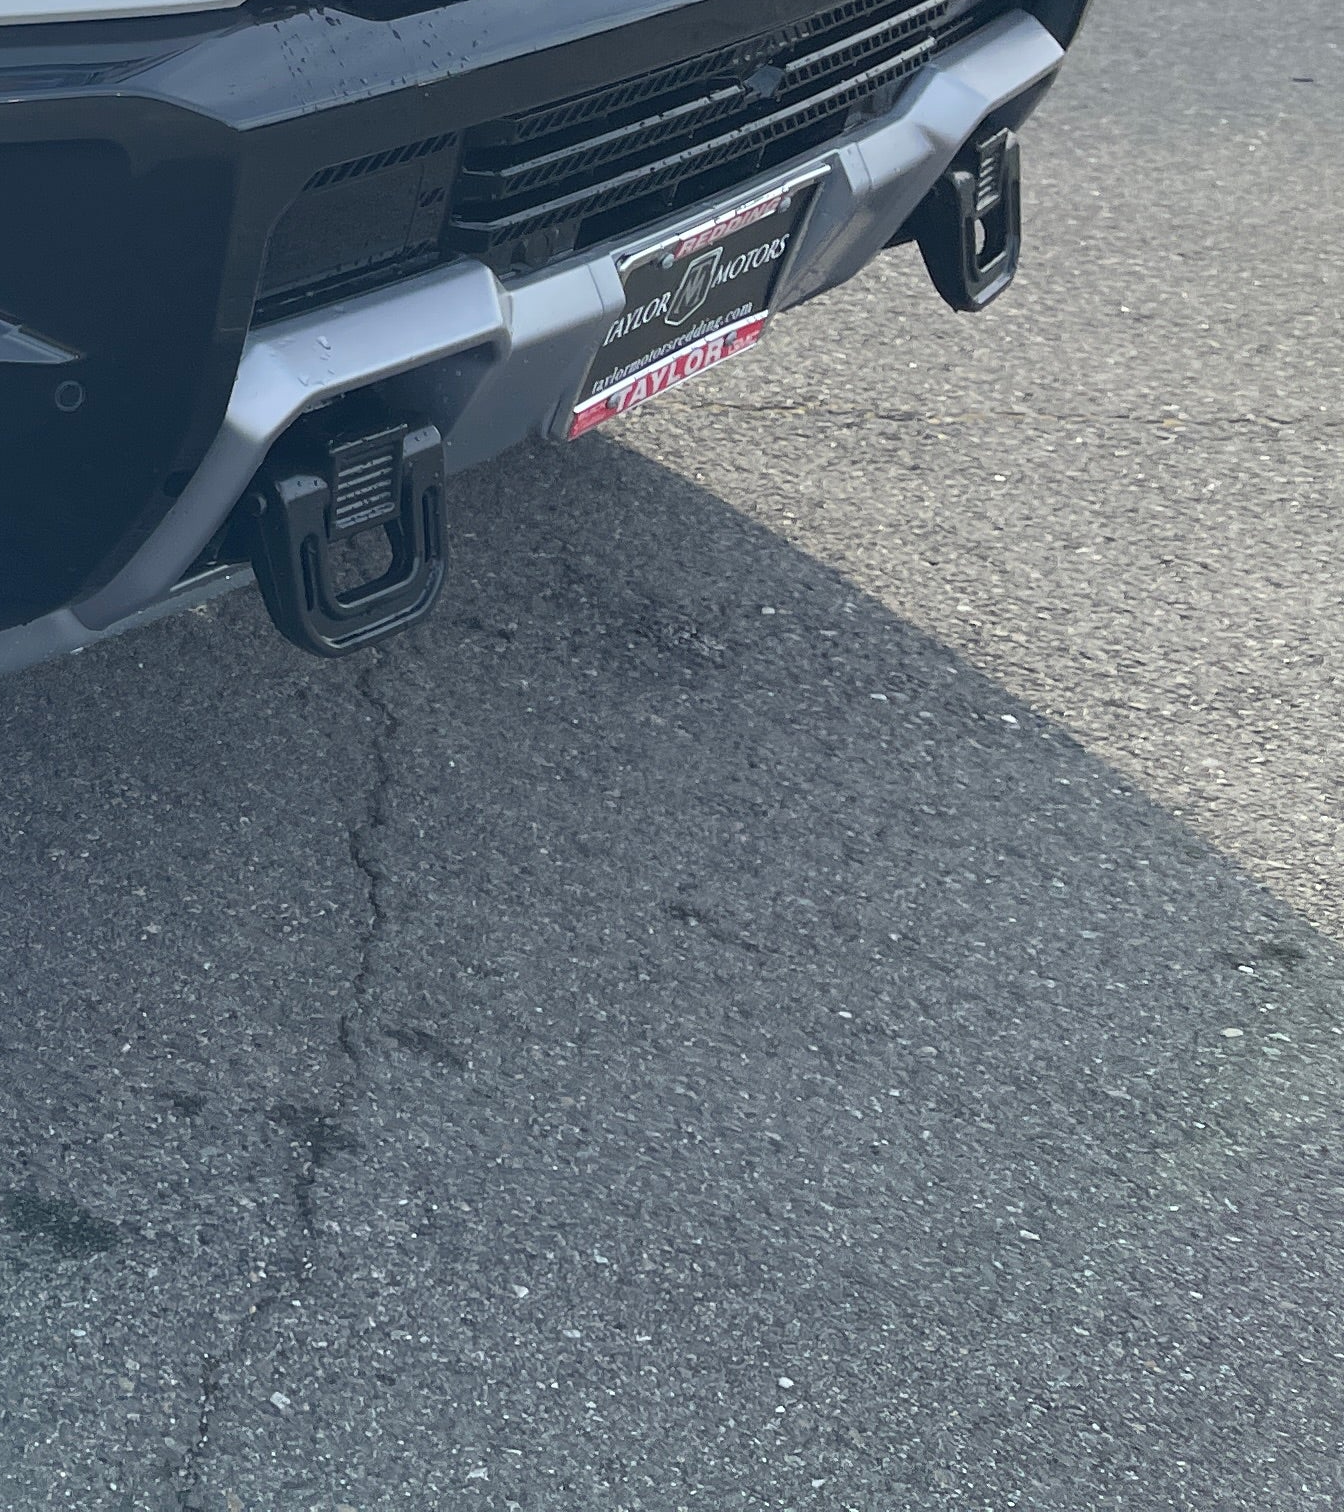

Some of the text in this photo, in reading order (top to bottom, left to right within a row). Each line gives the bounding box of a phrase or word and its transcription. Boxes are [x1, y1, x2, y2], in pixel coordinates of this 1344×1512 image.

[675, 195, 783, 258] REDDING
[602, 291, 672, 347] TAYLOR
[711, 233, 791, 289] MOTORS
[591, 301, 753, 395] taylormotorsredding.com
[615, 336, 725, 413] TAYLOR
